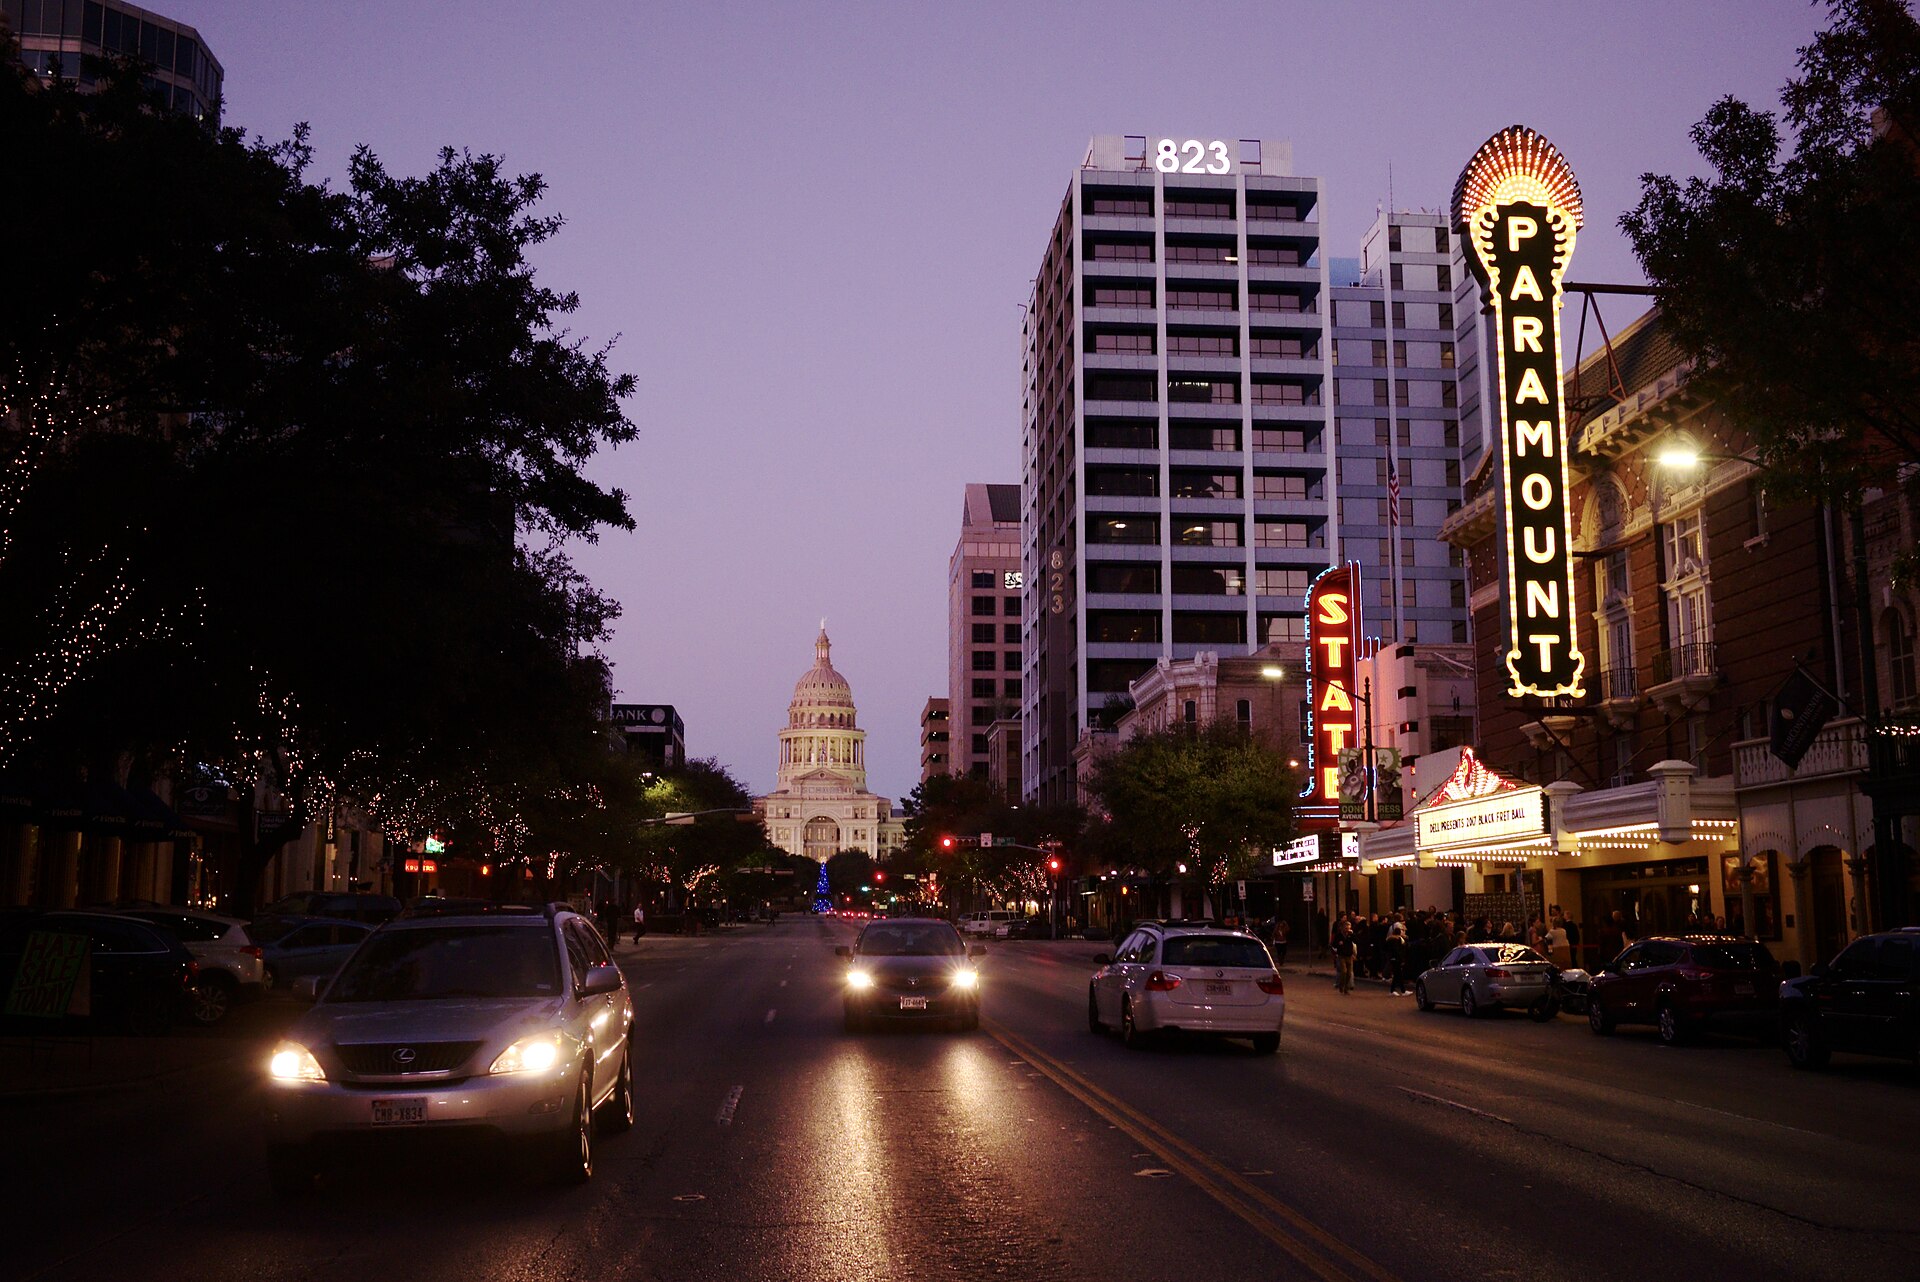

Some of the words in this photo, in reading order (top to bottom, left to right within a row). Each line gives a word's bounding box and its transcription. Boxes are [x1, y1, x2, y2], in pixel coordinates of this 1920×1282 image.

[1156, 138, 1231, 175] 823
[1507, 216, 1560, 673] PARAMOUNT
[1051, 550, 1065, 614] 823
[1318, 593, 1353, 799] STATE
[613, 709, 647, 721] ANK
[1429, 823, 1440, 833] DELL
[1441, 818, 1464, 831] PRESENTS
[1478, 813, 1495, 825] BLACK
[1496, 810, 1510, 822] FRET
[1511, 807, 1525, 820] BALL
[27, 933, 84, 960] HAT
[18, 957, 74, 988] SALE
